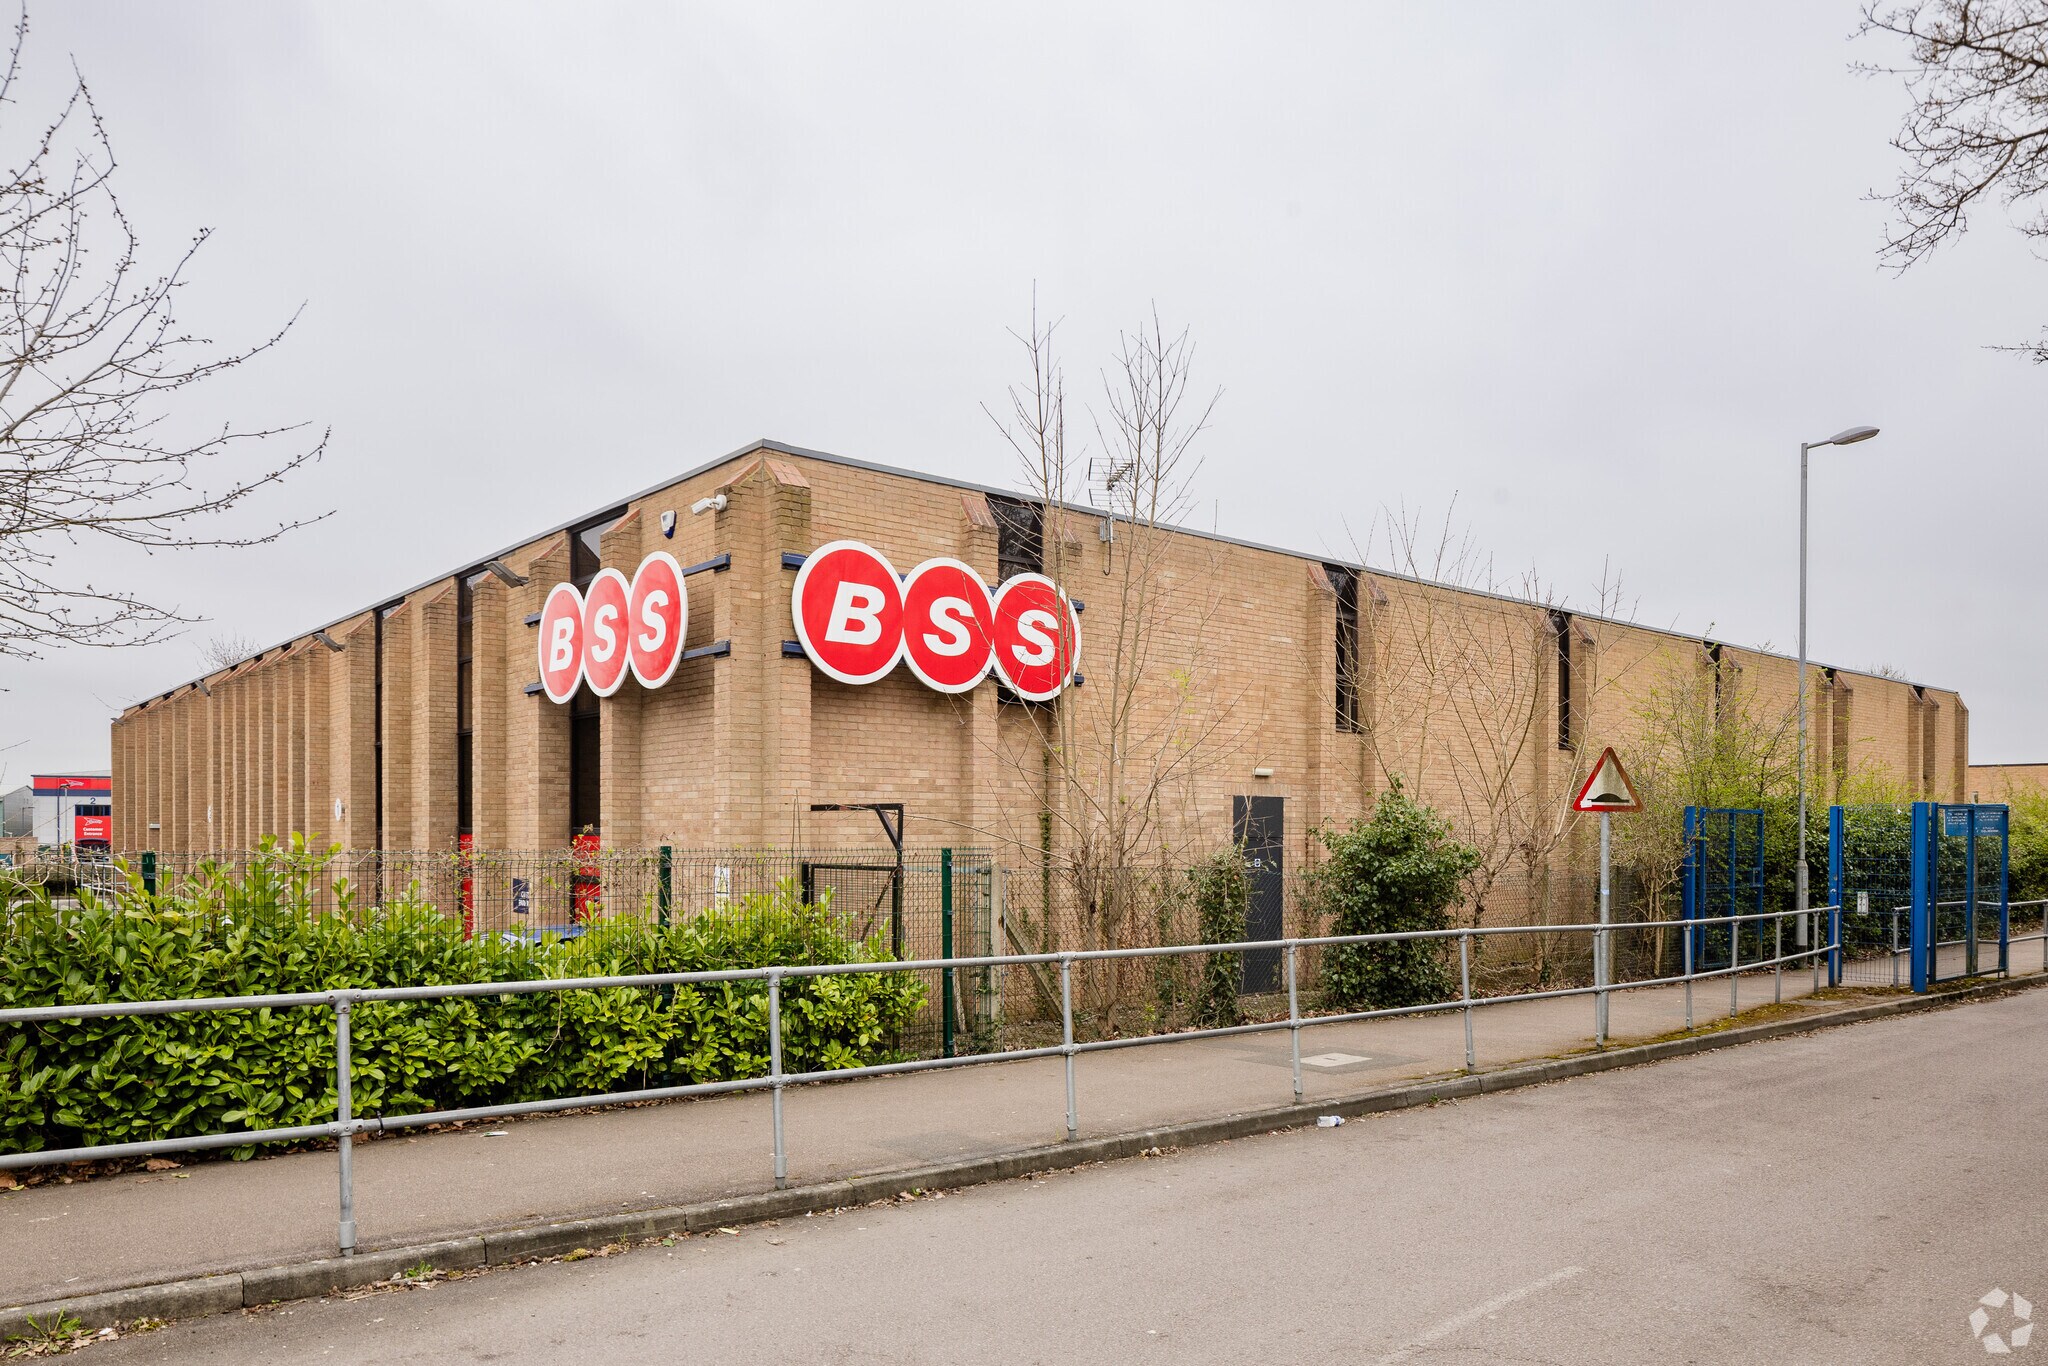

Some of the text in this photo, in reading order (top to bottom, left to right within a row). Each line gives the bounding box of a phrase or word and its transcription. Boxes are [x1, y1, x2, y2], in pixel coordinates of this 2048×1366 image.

[549, 589, 669, 672] BSS
[824, 581, 1059, 666] BSS
[90, 797, 96, 805] 2
